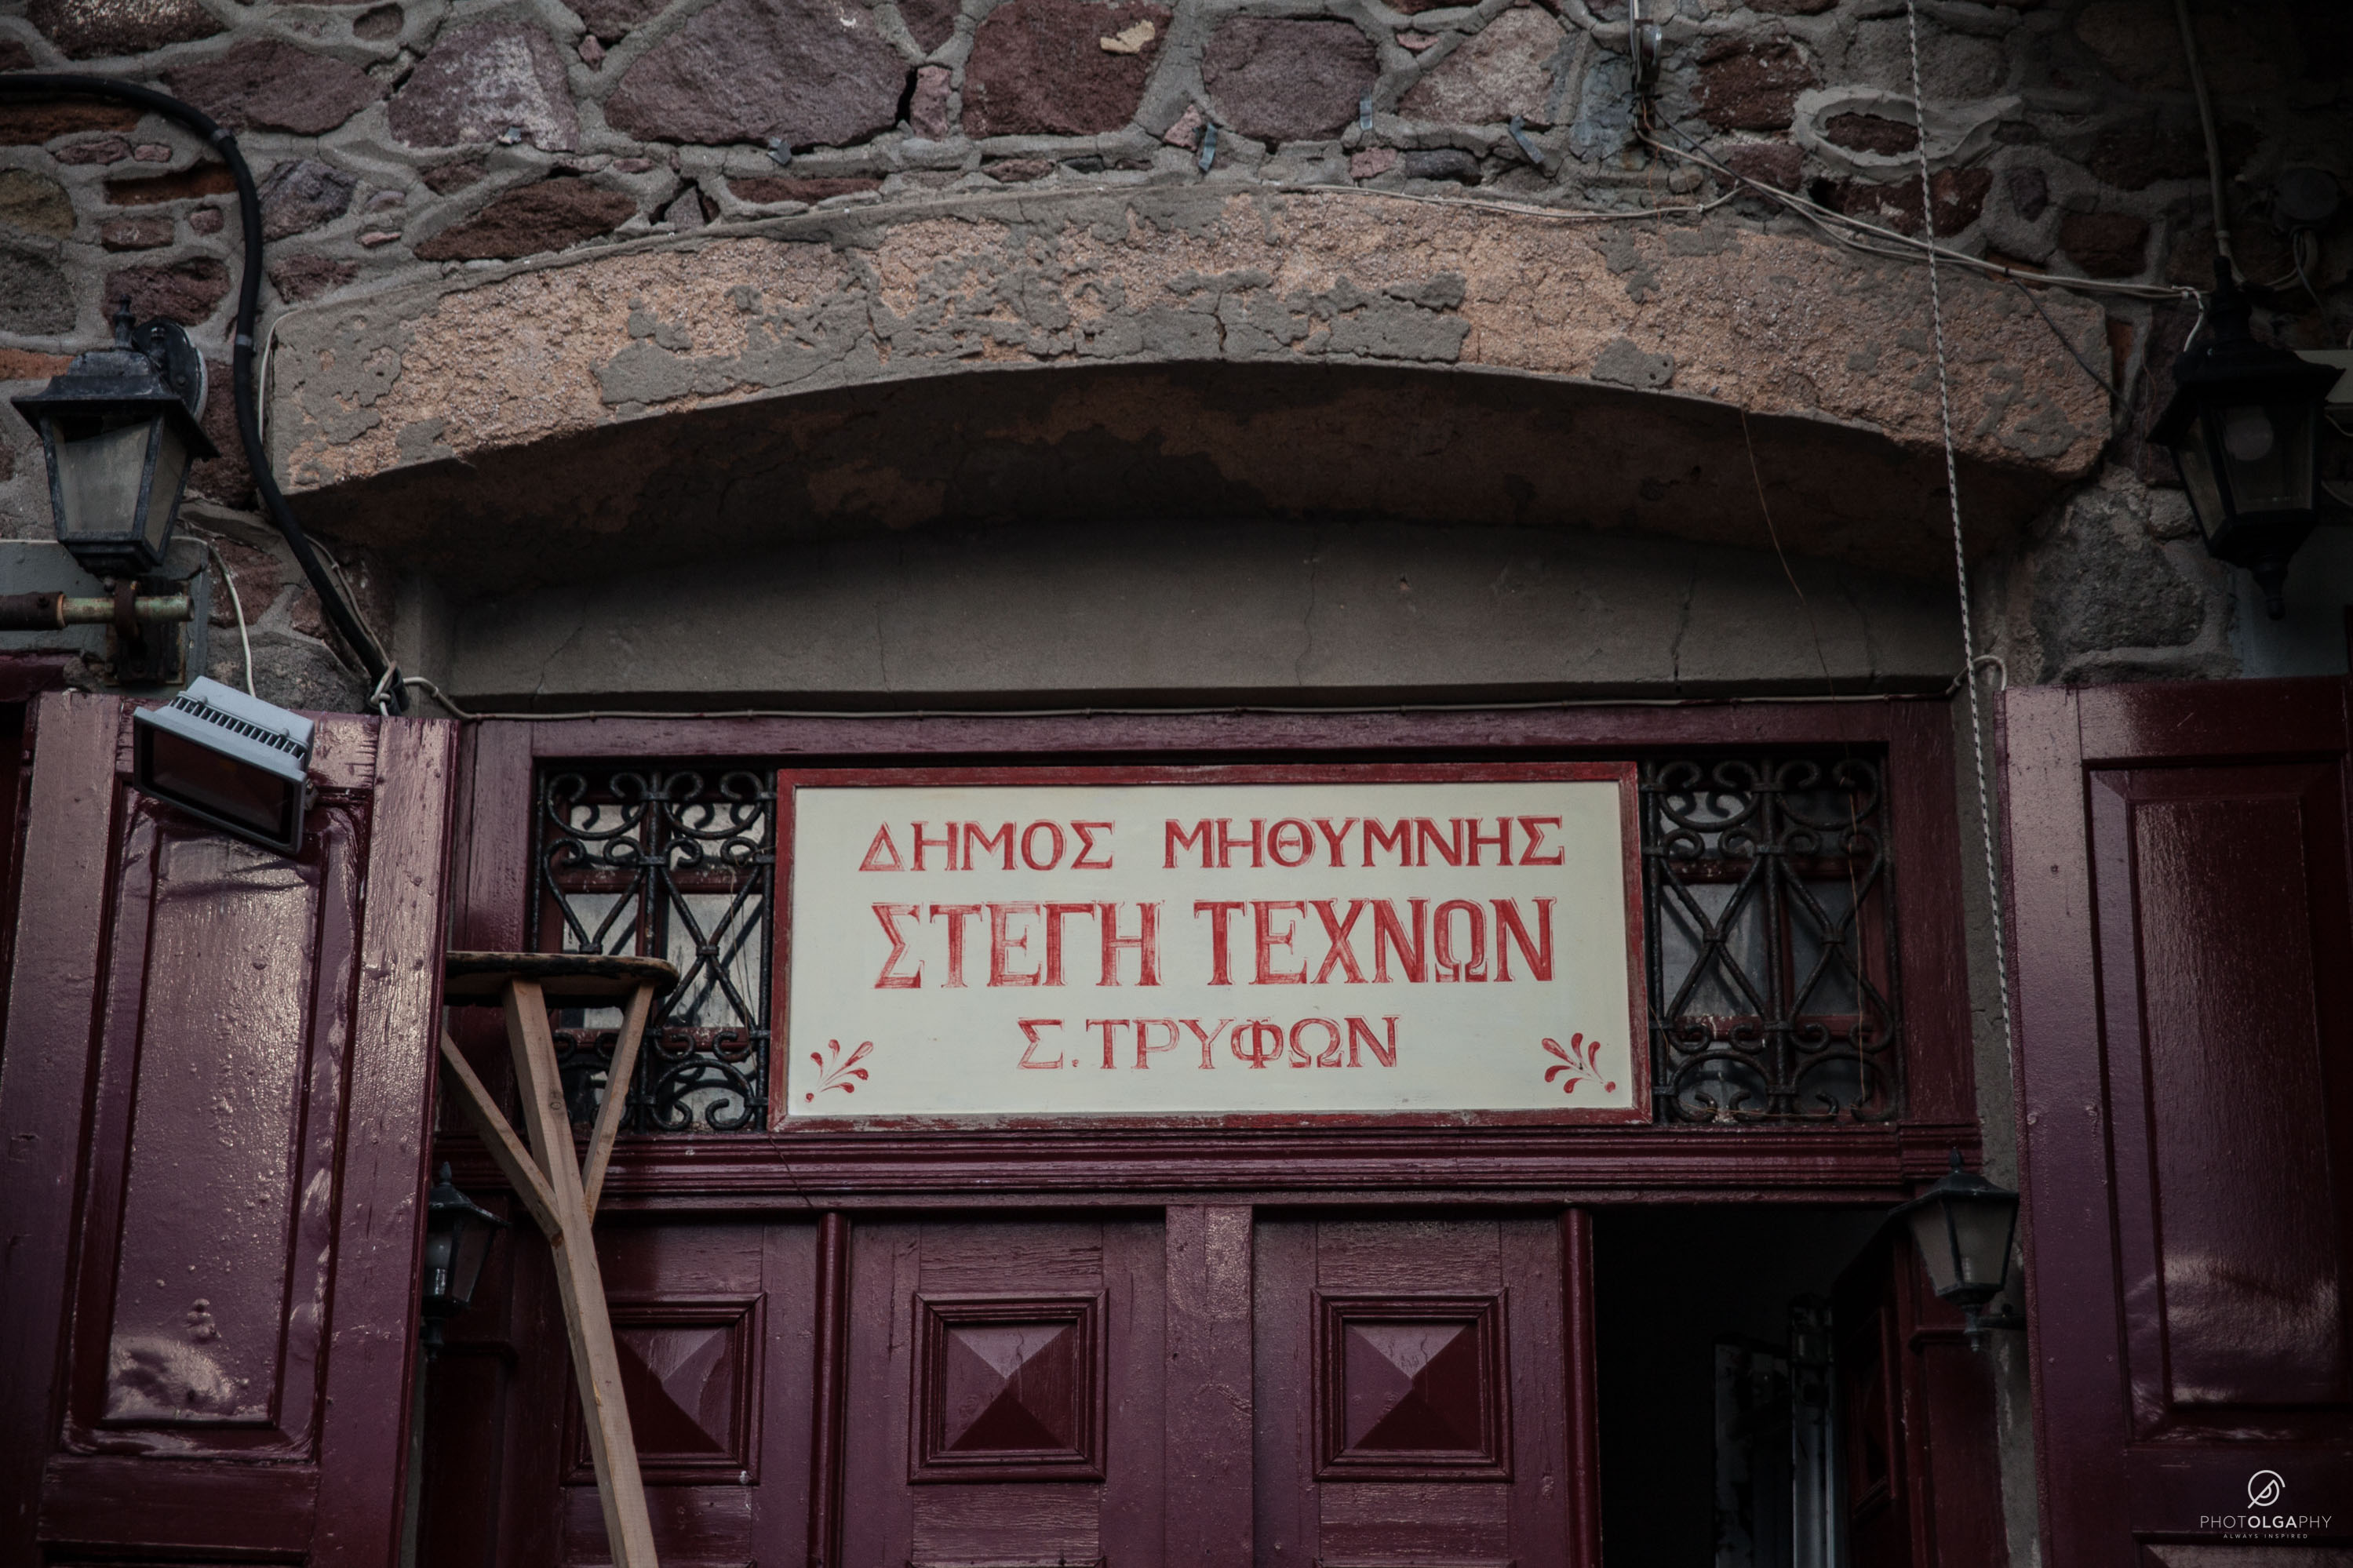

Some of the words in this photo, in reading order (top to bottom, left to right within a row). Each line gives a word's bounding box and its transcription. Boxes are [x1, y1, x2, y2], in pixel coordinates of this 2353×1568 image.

[858, 820, 1115, 871] ΔΗΜΟΣ
[1164, 816, 1565, 869] ΜΗΘΥΜΝΗΣ
[871, 900, 1164, 989] ΣΤΕΓΗ
[1193, 897, 1557, 985] ΤΕΧΝΩΝ
